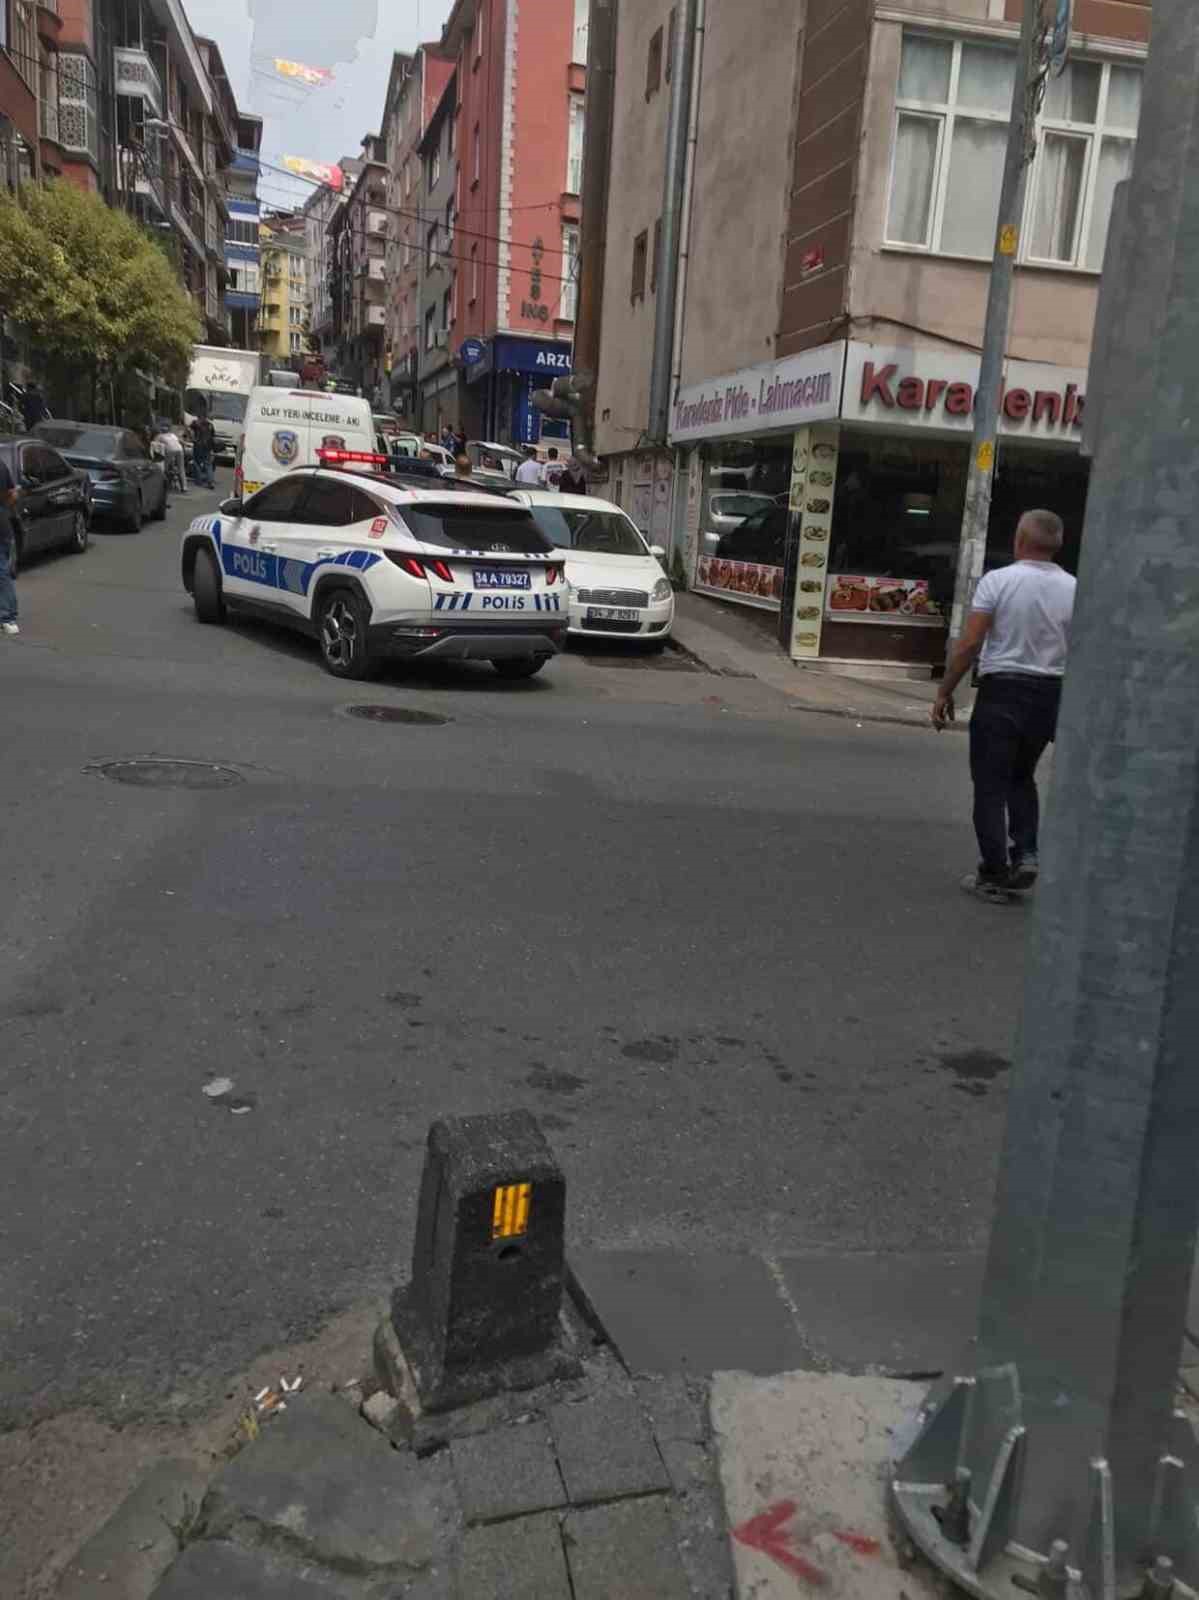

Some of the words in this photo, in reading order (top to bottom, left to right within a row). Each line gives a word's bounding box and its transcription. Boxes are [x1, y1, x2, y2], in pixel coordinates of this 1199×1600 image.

[724, 385, 749, 421] Pide
[758, 371, 831, 415] Lahmacun
[860, 361, 1086, 427] Karaeni
[474, 572, 488, 584] 34
[490, 573, 498, 585] A
[482, 595, 525, 609] POLİS
